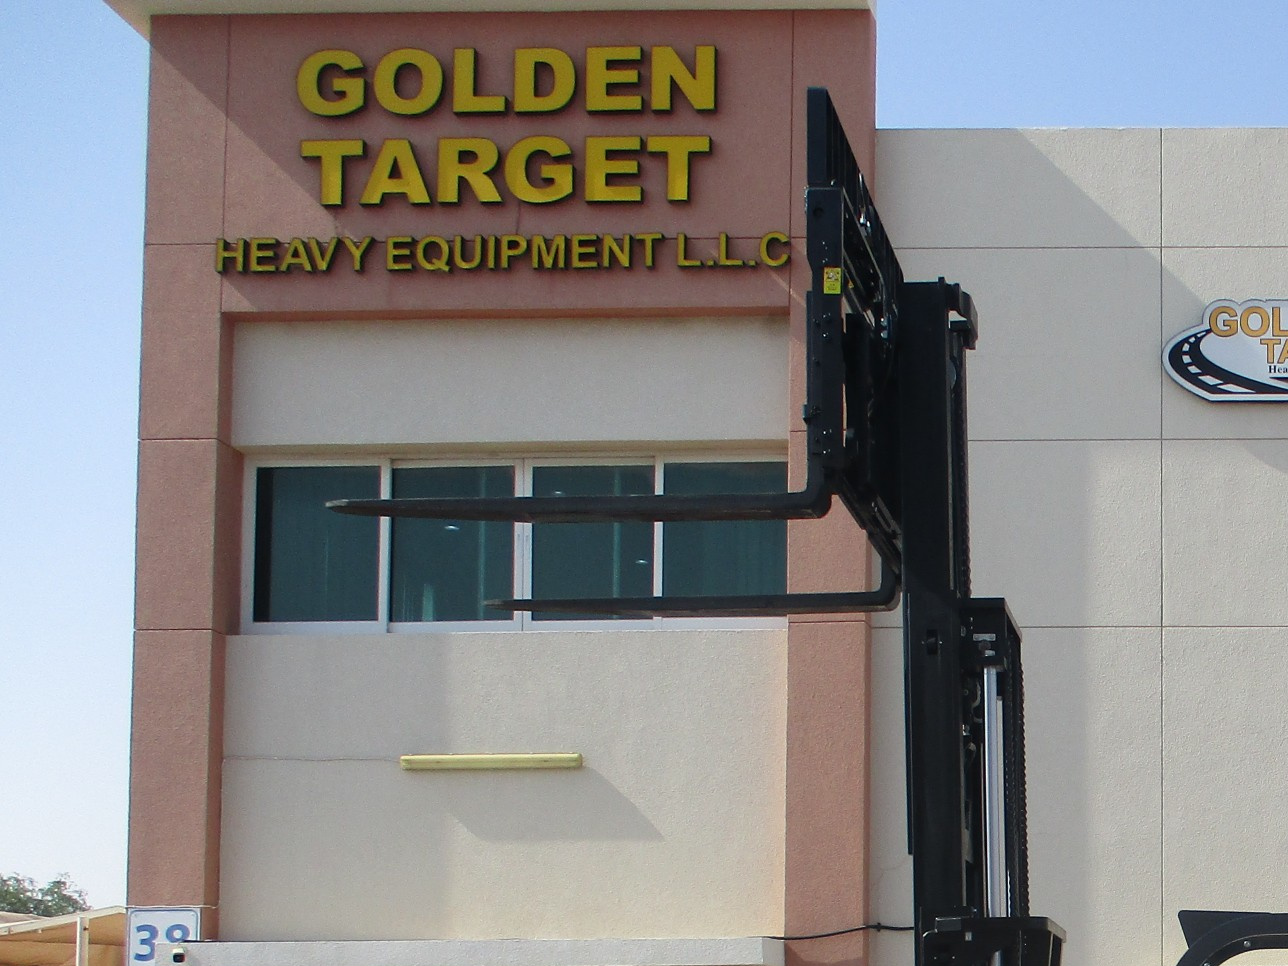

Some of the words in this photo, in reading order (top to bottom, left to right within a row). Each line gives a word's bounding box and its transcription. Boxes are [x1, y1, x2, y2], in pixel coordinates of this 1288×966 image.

[297, 45, 717, 116] GOLDEN
[299, 135, 712, 206] TARGET
[215, 235, 376, 275] HEAVY
[385, 231, 665, 274] EQUIPMENT
[676, 230, 793, 270] L.L.C
